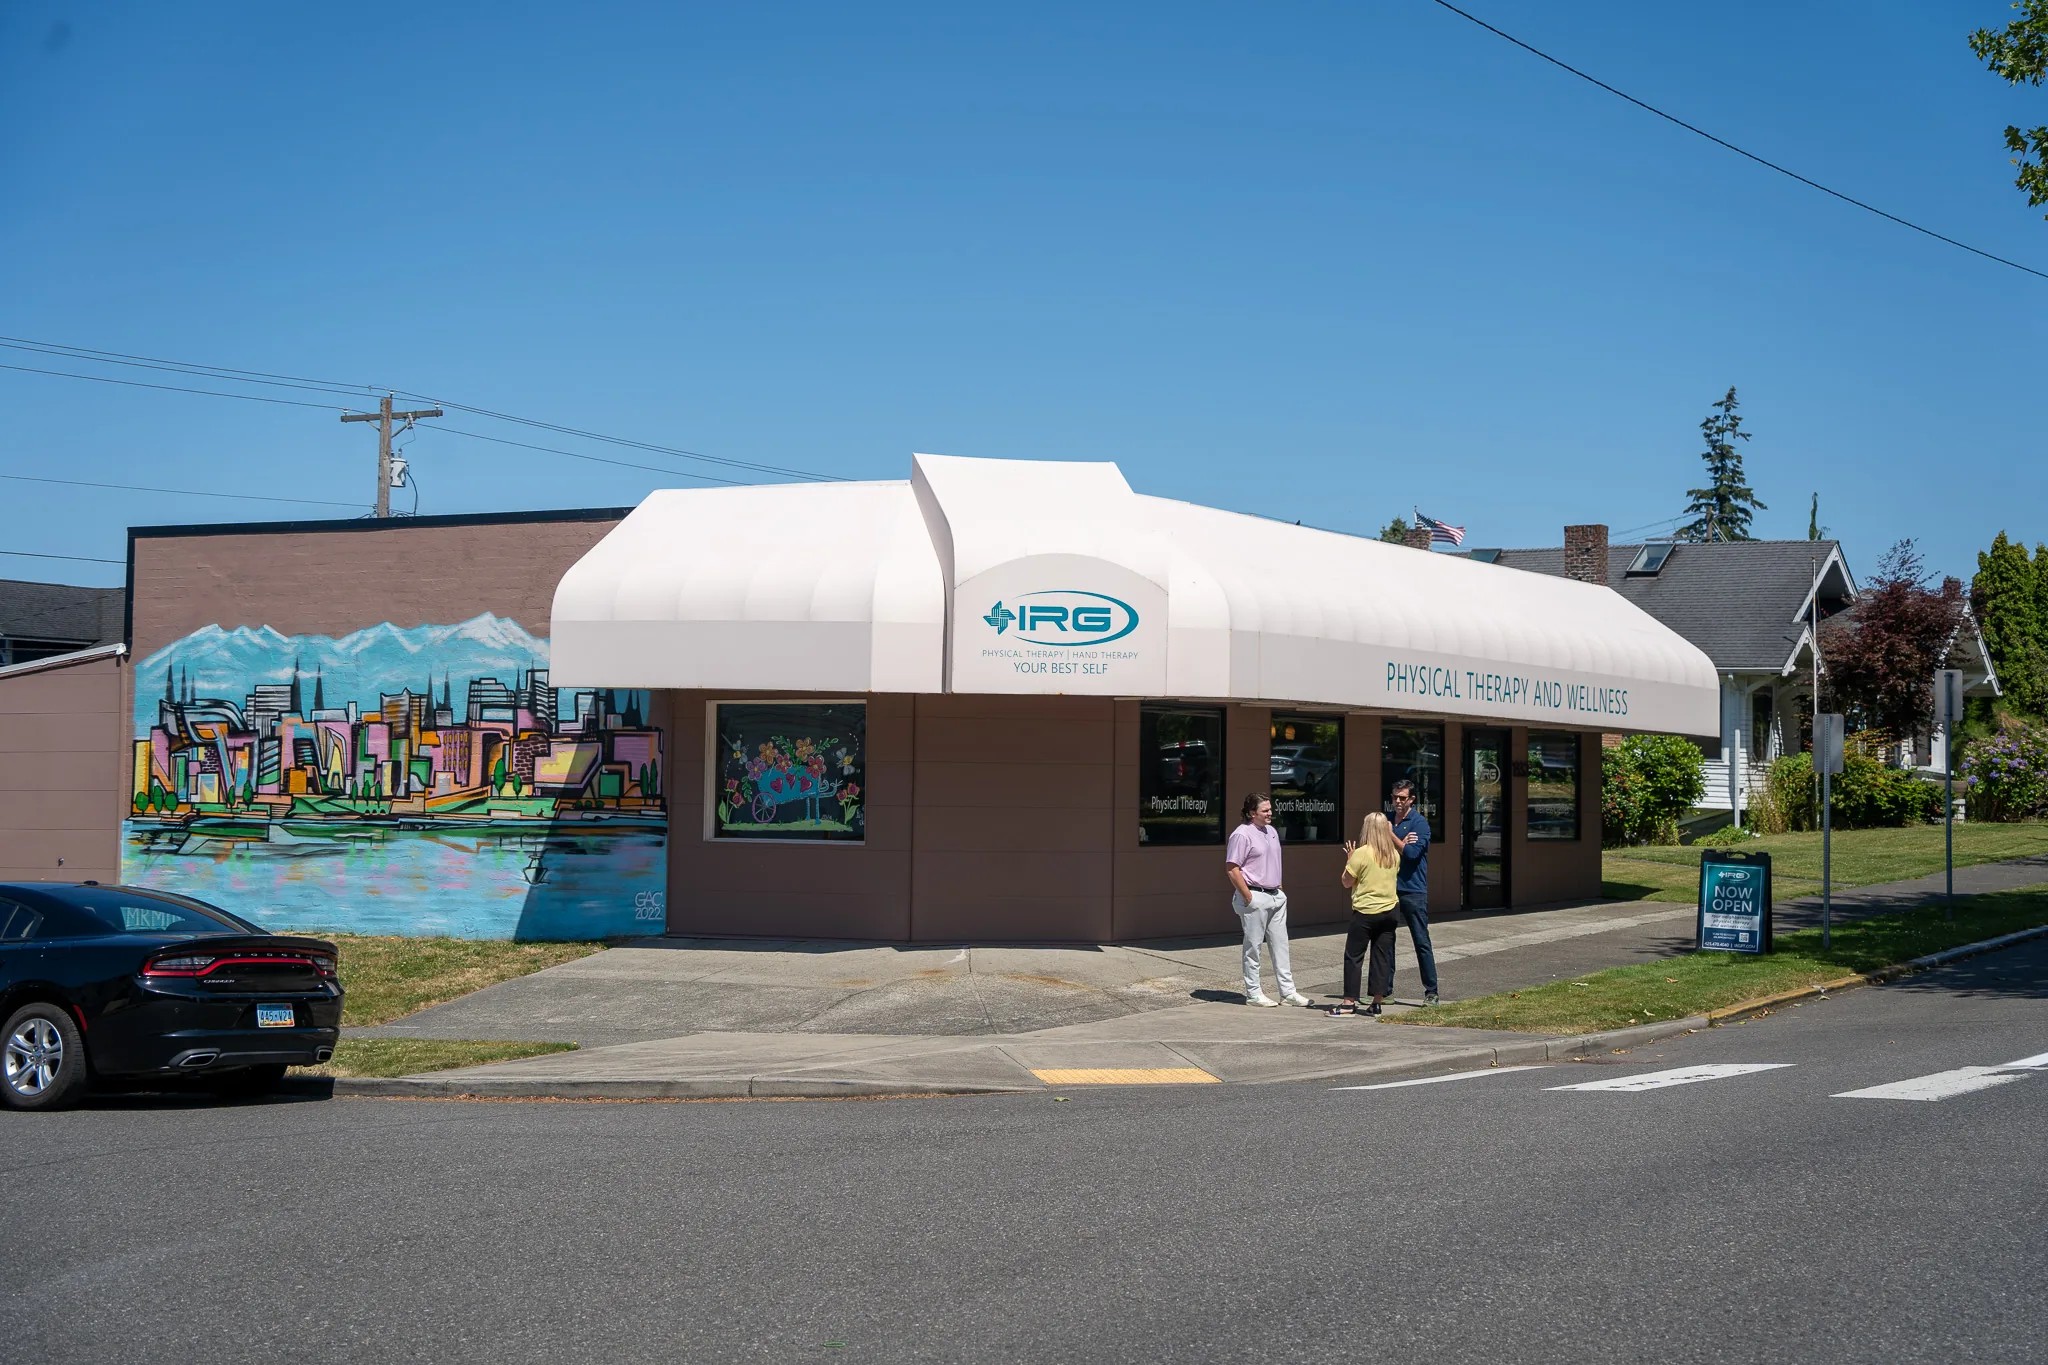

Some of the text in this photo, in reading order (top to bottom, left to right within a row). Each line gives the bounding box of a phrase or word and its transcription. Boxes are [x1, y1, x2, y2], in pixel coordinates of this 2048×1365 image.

[1018, 605, 1112, 632] IRG
[982, 649, 1139, 660] PHYSICAL THERAPY HAND THERAPY
[1013, 662, 1108, 675] YOUR BEST SELF
[1386, 661, 1629, 716] PHYSICAL THERAPY AND WELLNESS
[1151, 795, 1208, 815] Physical Therapy
[1274, 798, 1335, 814] Sports Rehabilitation
[1714, 885, 1753, 899] NOW
[1712, 899, 1752, 913] OPEN
[635, 907, 663, 920] 2022
